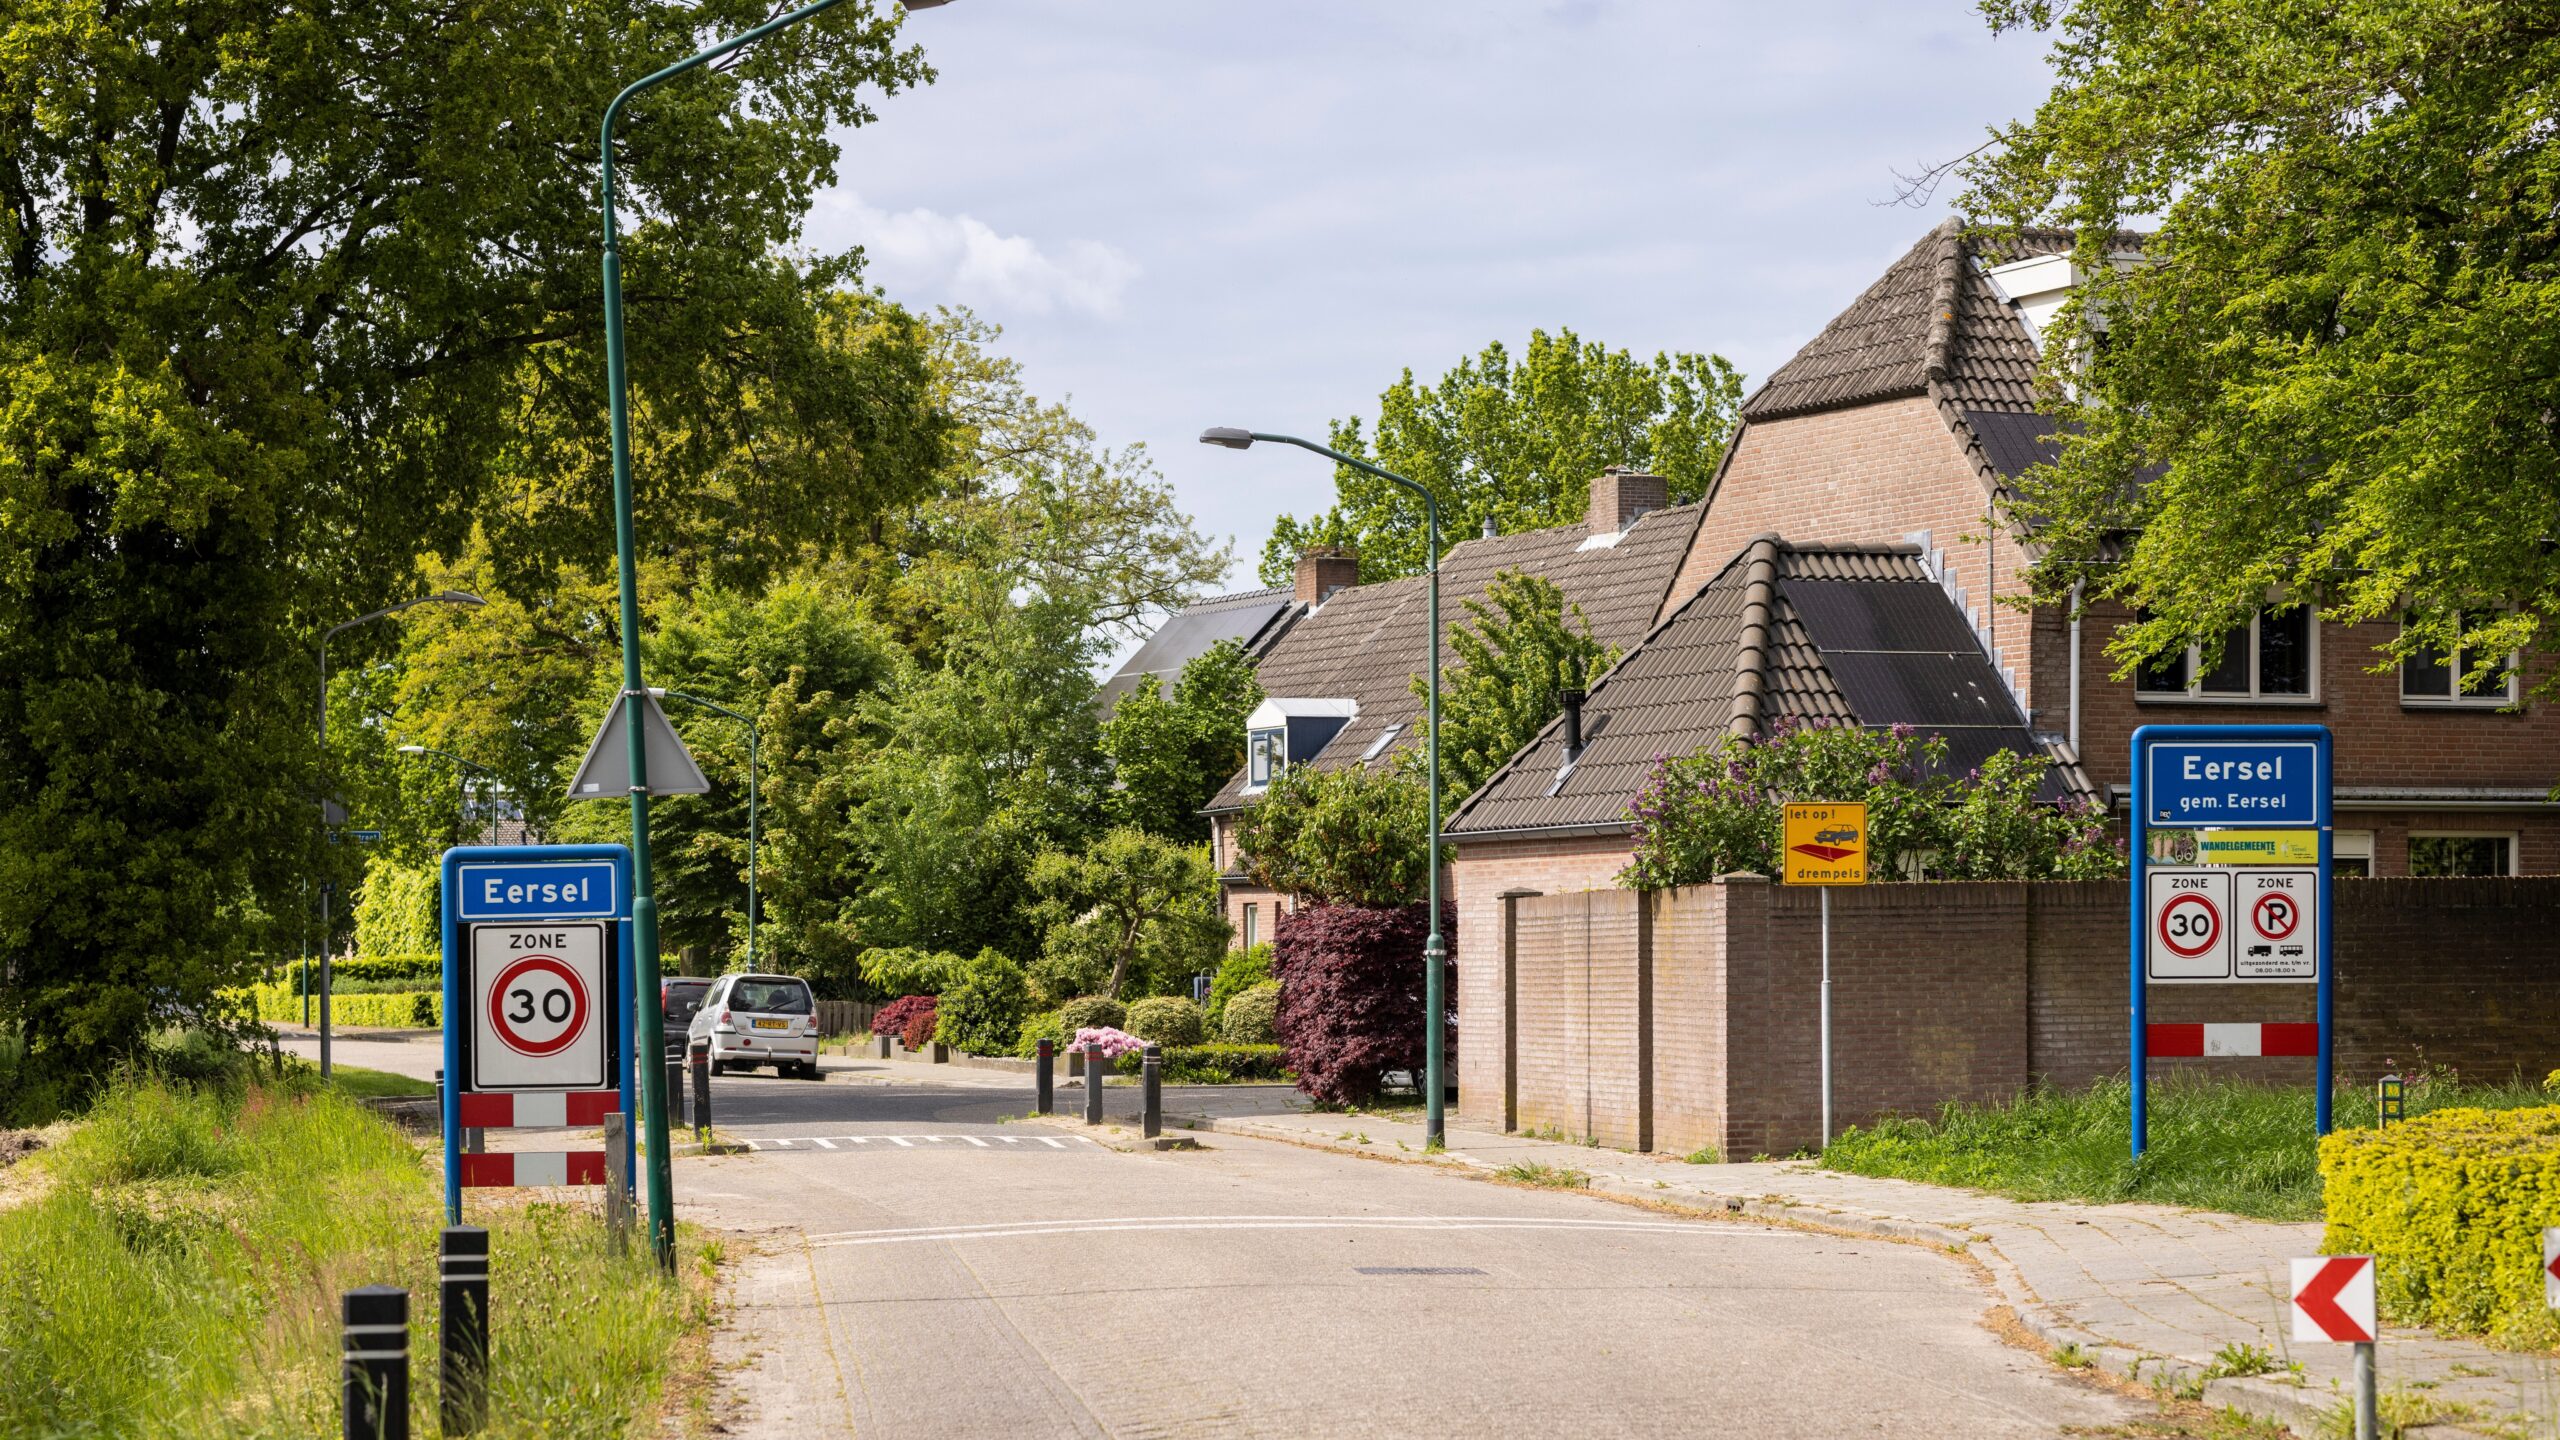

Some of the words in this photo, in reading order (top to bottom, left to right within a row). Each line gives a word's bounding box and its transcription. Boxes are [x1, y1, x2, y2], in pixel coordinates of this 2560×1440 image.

[2183, 755, 2282, 781] Eersel
[2180, 796, 2222, 812] gem.
[2228, 793, 2286, 808] Eersel
[1790, 809, 1807, 819] let
[2200, 841, 2276, 851] WANDELGEMEENTE
[1798, 868, 1860, 880] drempels
[484, 877, 589, 904] Eersel
[2171, 878, 2209, 889] ZONE
[2257, 878, 2294, 888] ZONE
[2171, 914, 2210, 937] 30
[2268, 903, 2287, 931] P
[509, 933, 567, 949] ZONE
[508, 988, 571, 1024] 30
